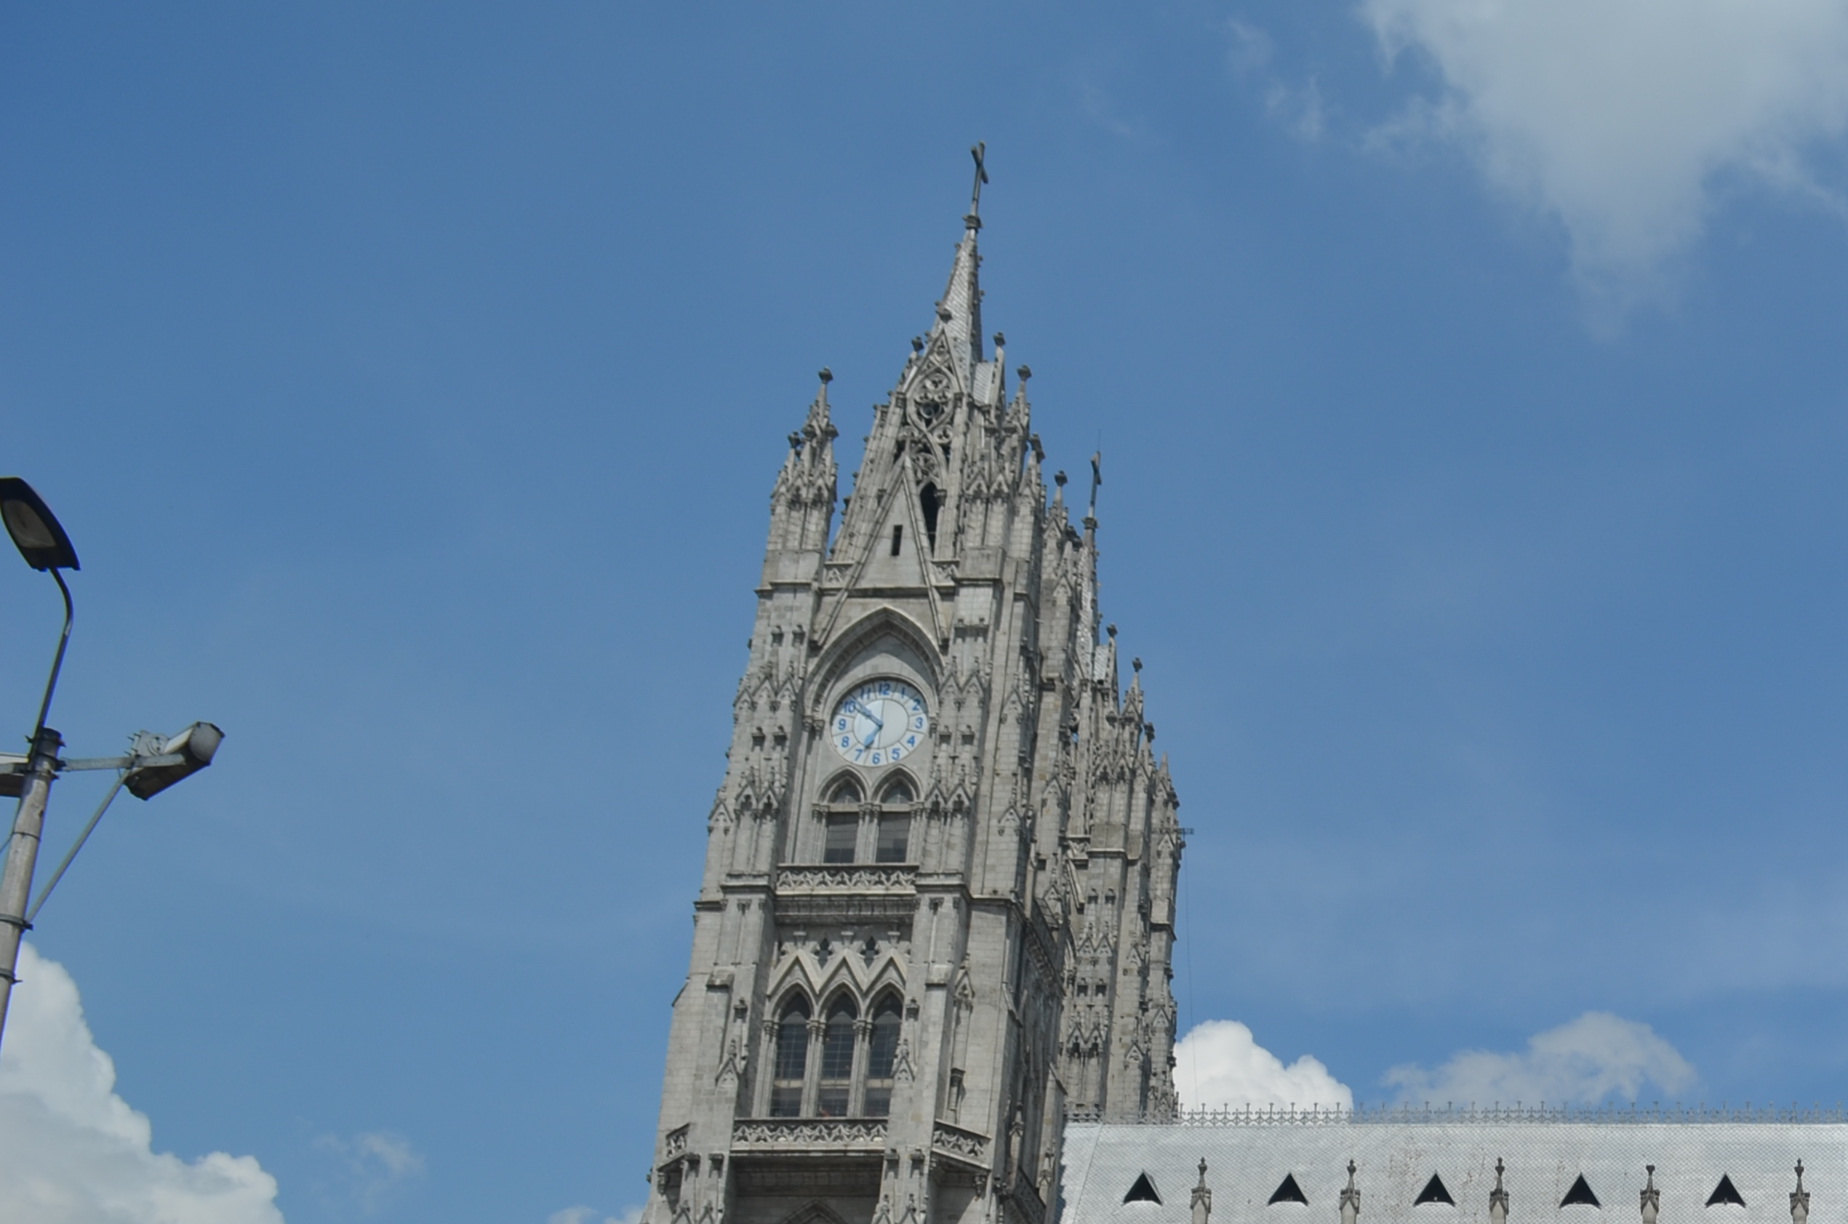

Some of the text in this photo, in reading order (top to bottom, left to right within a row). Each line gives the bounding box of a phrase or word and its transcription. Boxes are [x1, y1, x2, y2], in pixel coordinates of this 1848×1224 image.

[861, 687, 871, 699] 11
[878, 683, 891, 695] 12
[843, 700, 856, 713] 10
[912, 699, 921, 711] 2
[838, 718, 847, 730] 9
[915, 717, 923, 729] 3
[841, 736, 850, 748] 8
[906, 735, 916, 747] 4
[855, 749, 863, 761] 7
[872, 752, 880, 764] 6
[892, 748, 900, 760] 5
